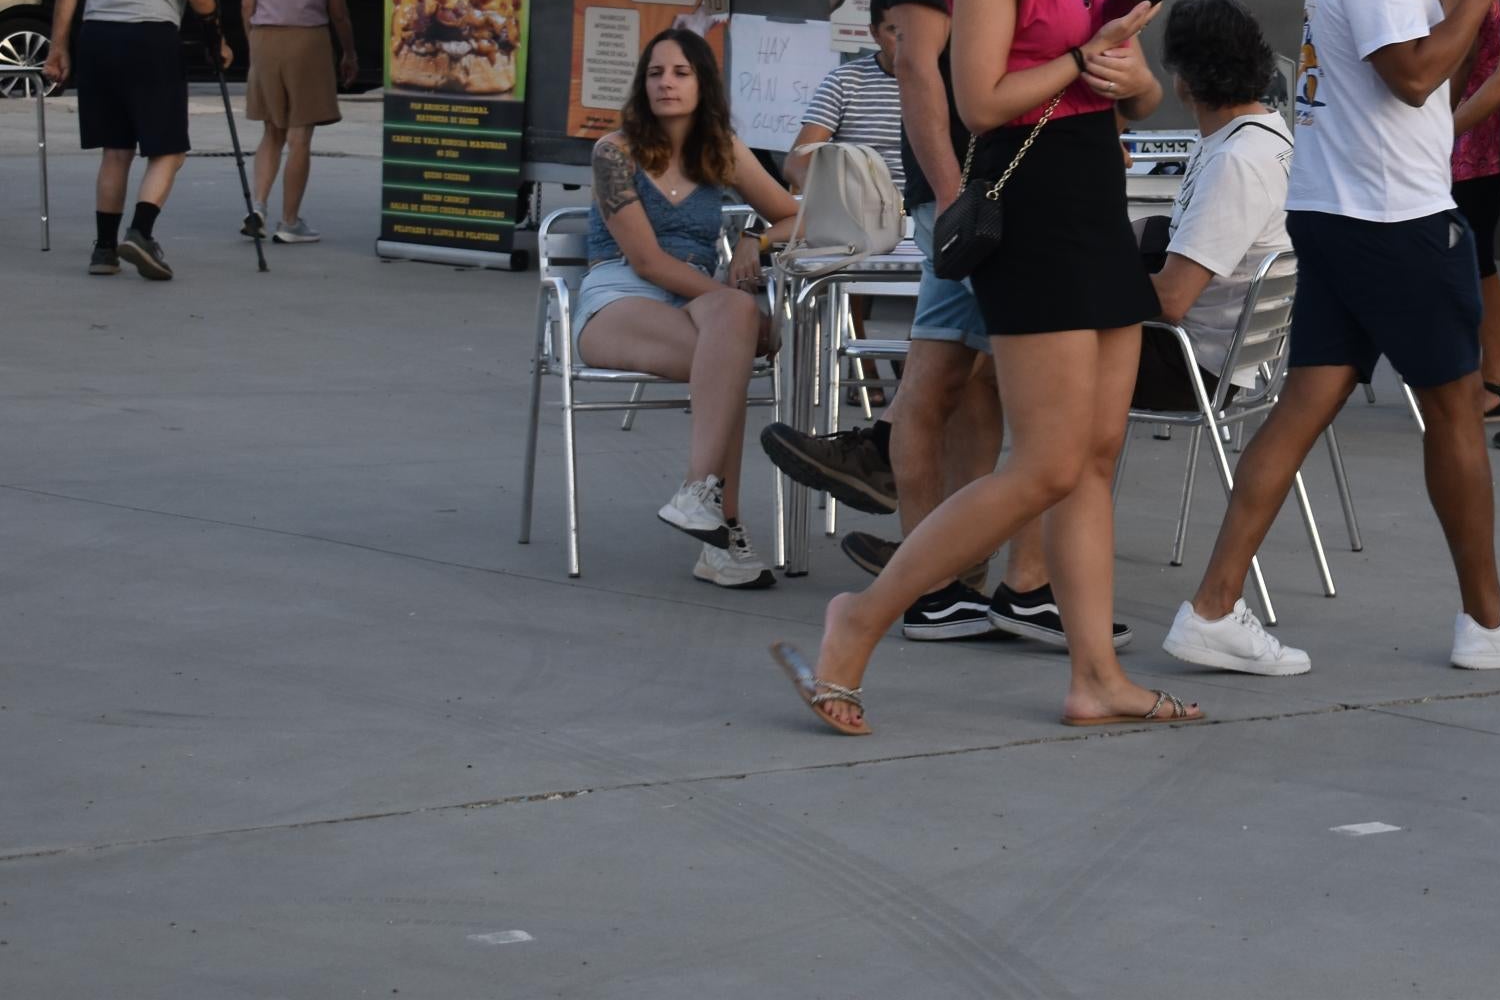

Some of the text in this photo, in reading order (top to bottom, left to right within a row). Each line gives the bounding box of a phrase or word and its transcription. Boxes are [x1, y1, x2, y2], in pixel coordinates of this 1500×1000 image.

[758, 35, 791, 64] HAY
[738, 71, 813, 105] PAN SI
[752, 112, 801, 134] GLUTE
